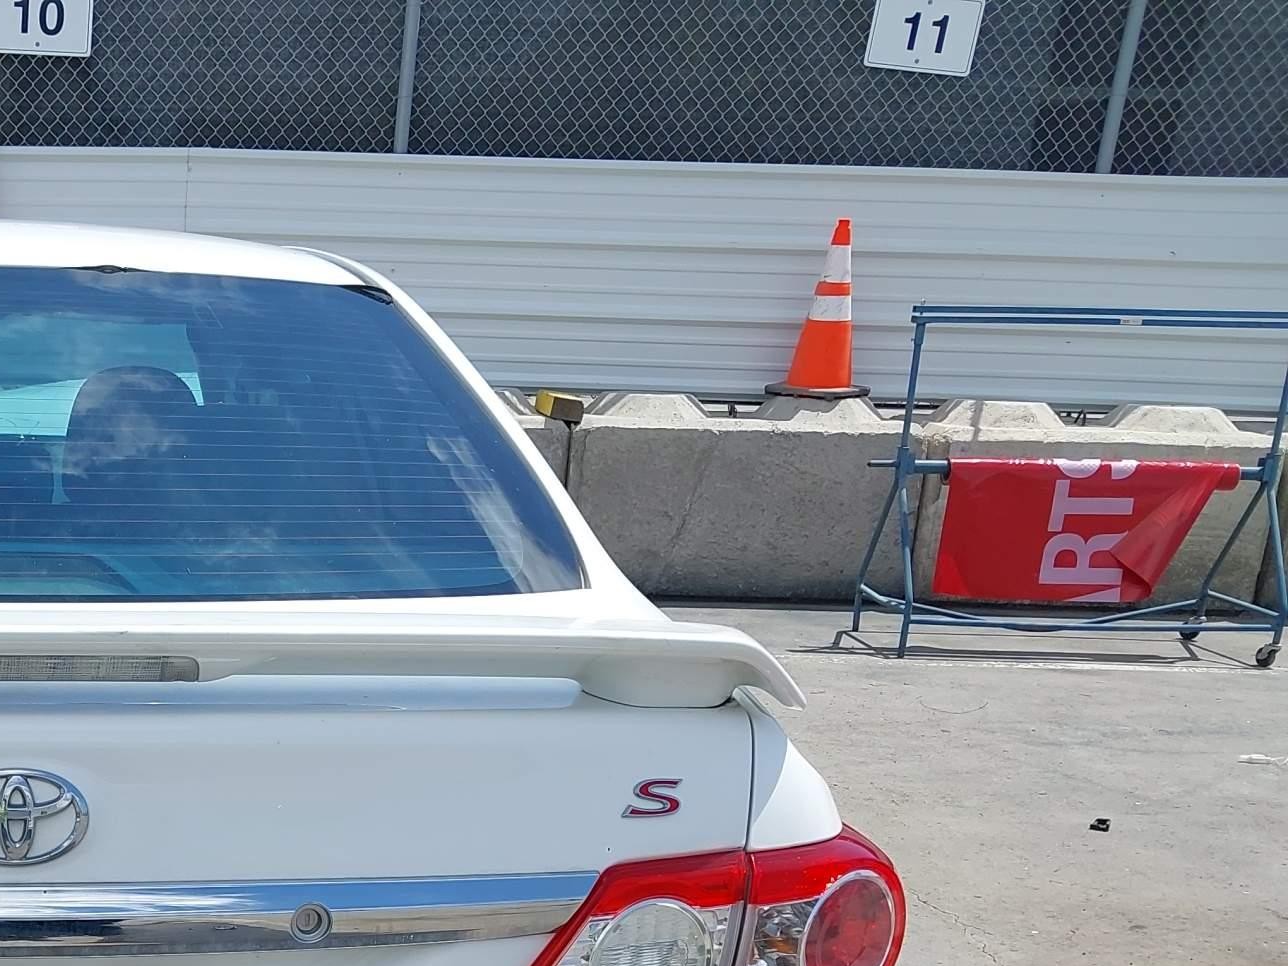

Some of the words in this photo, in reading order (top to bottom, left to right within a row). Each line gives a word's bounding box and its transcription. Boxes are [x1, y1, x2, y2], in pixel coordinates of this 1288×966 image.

[13, 0, 64, 35] 10
[904, 11, 949, 53] 11
[621, 778, 683, 818] S
